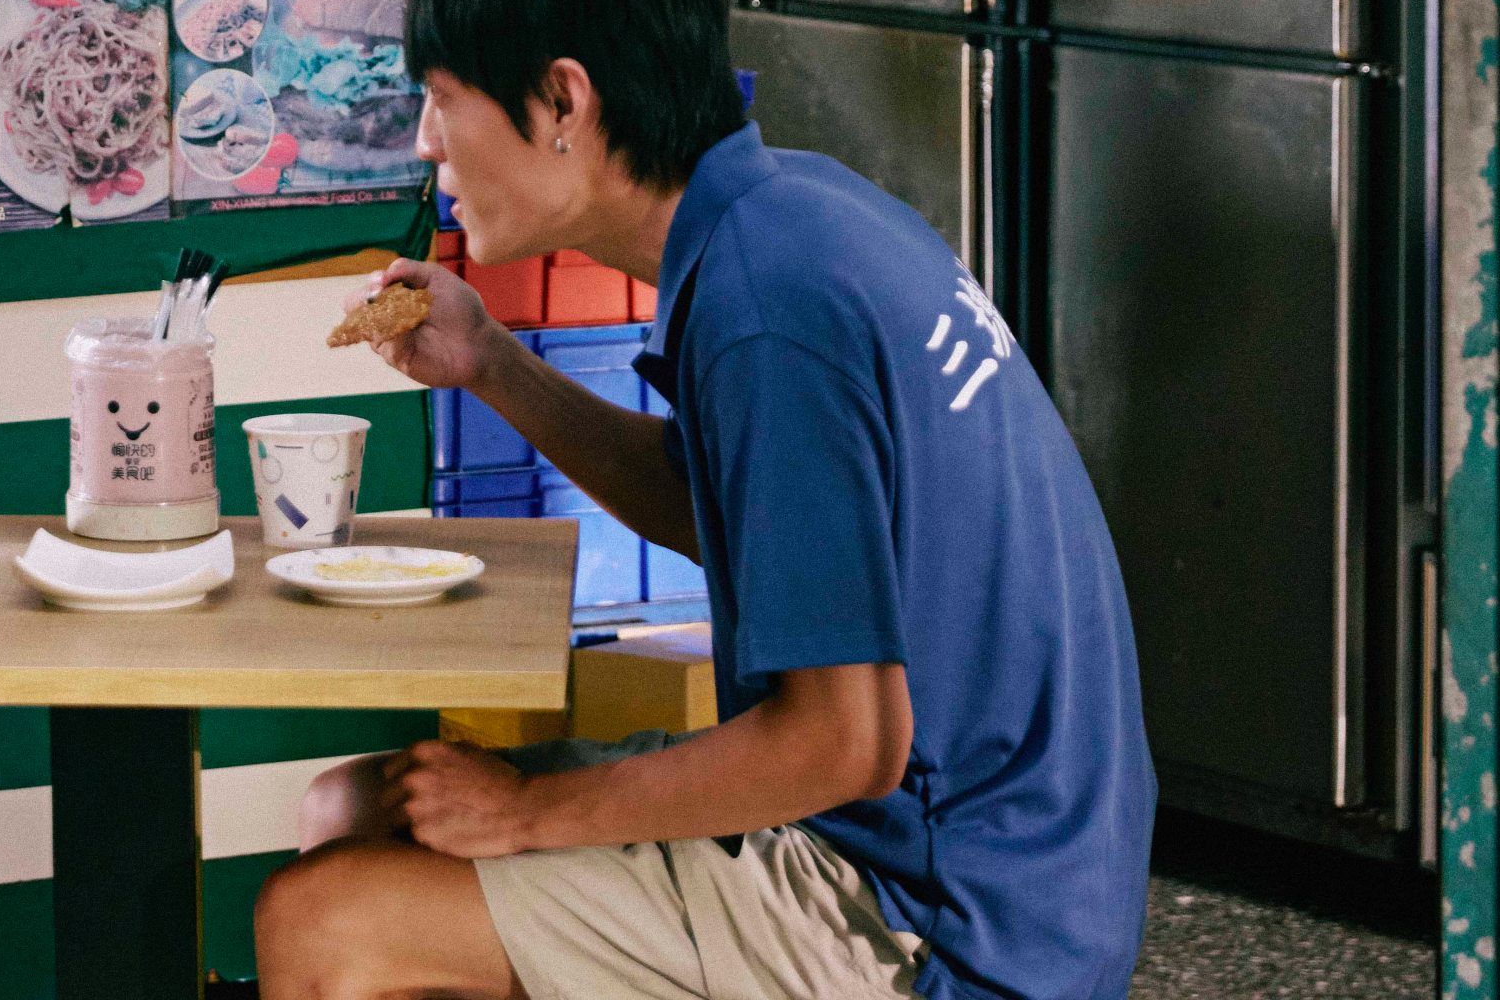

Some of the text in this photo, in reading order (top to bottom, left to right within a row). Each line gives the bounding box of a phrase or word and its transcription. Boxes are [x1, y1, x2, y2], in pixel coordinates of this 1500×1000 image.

[111, 442, 156, 457] 愉快的
[111, 466, 155, 481] 美食吧
